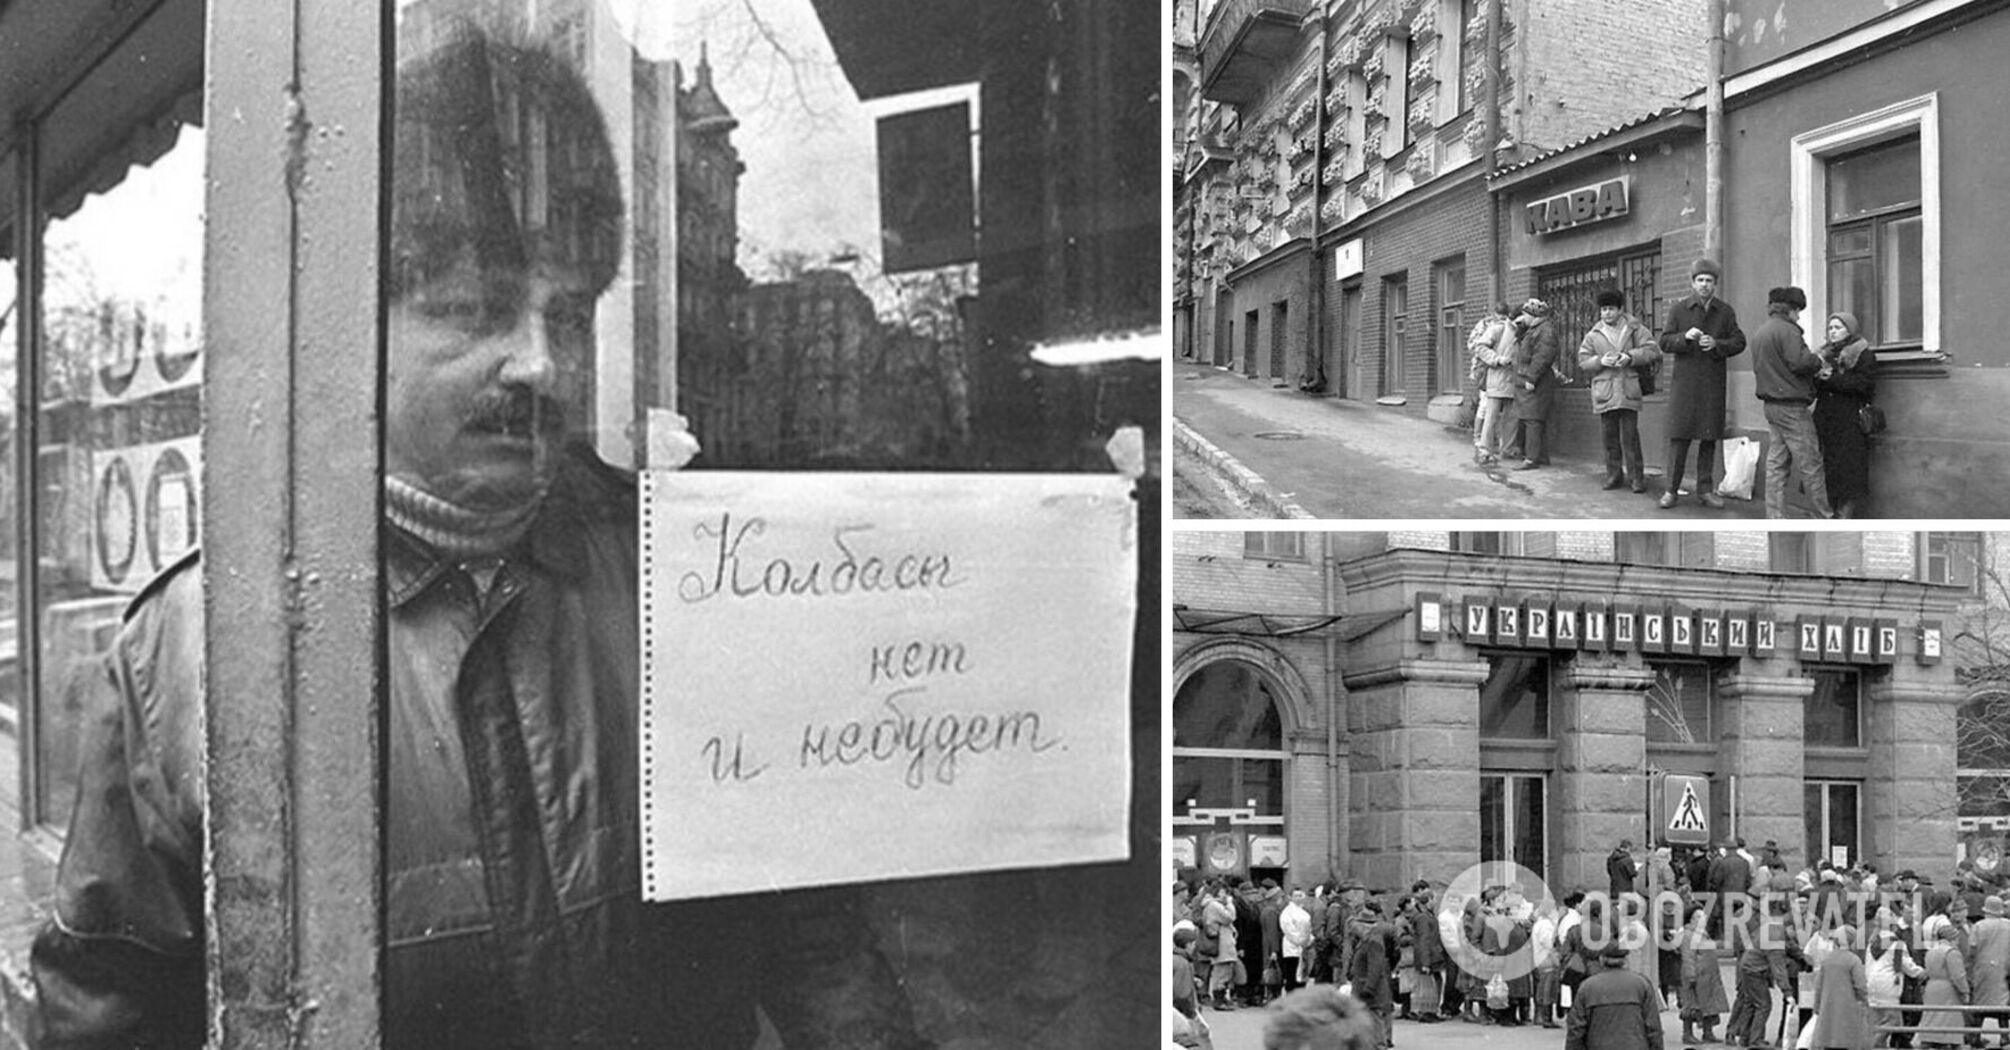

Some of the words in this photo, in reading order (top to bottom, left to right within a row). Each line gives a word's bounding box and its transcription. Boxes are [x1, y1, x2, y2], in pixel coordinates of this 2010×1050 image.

[1525, 181, 1627, 235] КАВА
[678, 512, 968, 602] Колбасы
[870, 640, 968, 684] нет
[1802, 624, 1895, 655] ХЛІБ
[702, 733, 770, 780] и
